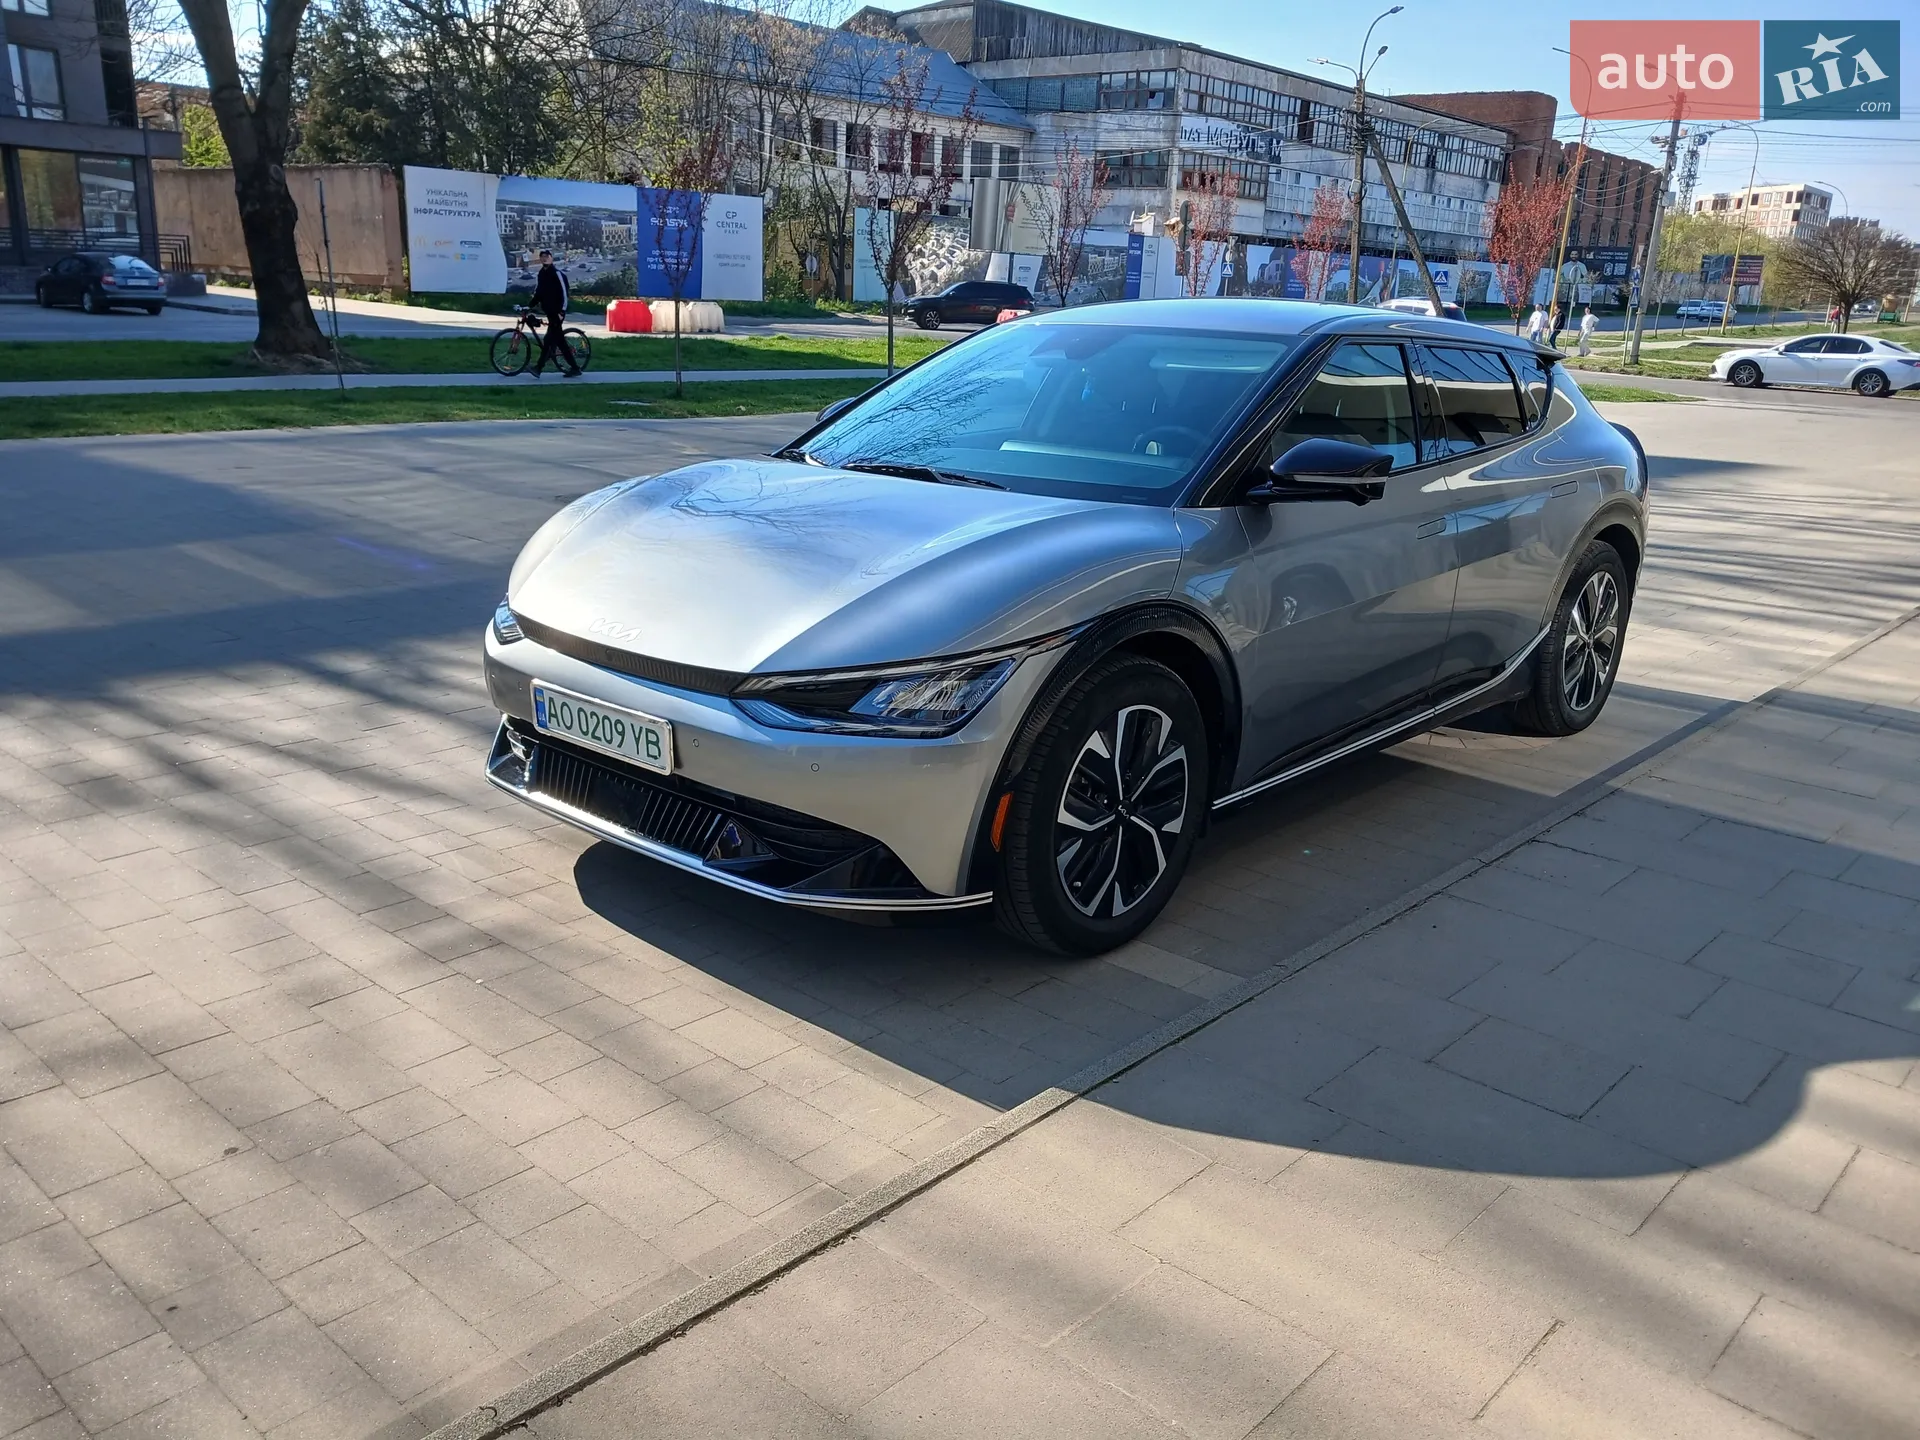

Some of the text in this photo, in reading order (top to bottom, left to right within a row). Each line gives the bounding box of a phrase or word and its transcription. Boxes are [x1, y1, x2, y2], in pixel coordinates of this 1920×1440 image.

[426, 188, 468, 198] УНІКАЛЬНА
[428, 197, 468, 207] МАЙБУТНЯ
[413, 207, 481, 218] ІНФРАСТРУКТУРА
[716, 220, 748, 230] CENTRAL
[548, 696, 662, 761] AO 0209 YB
